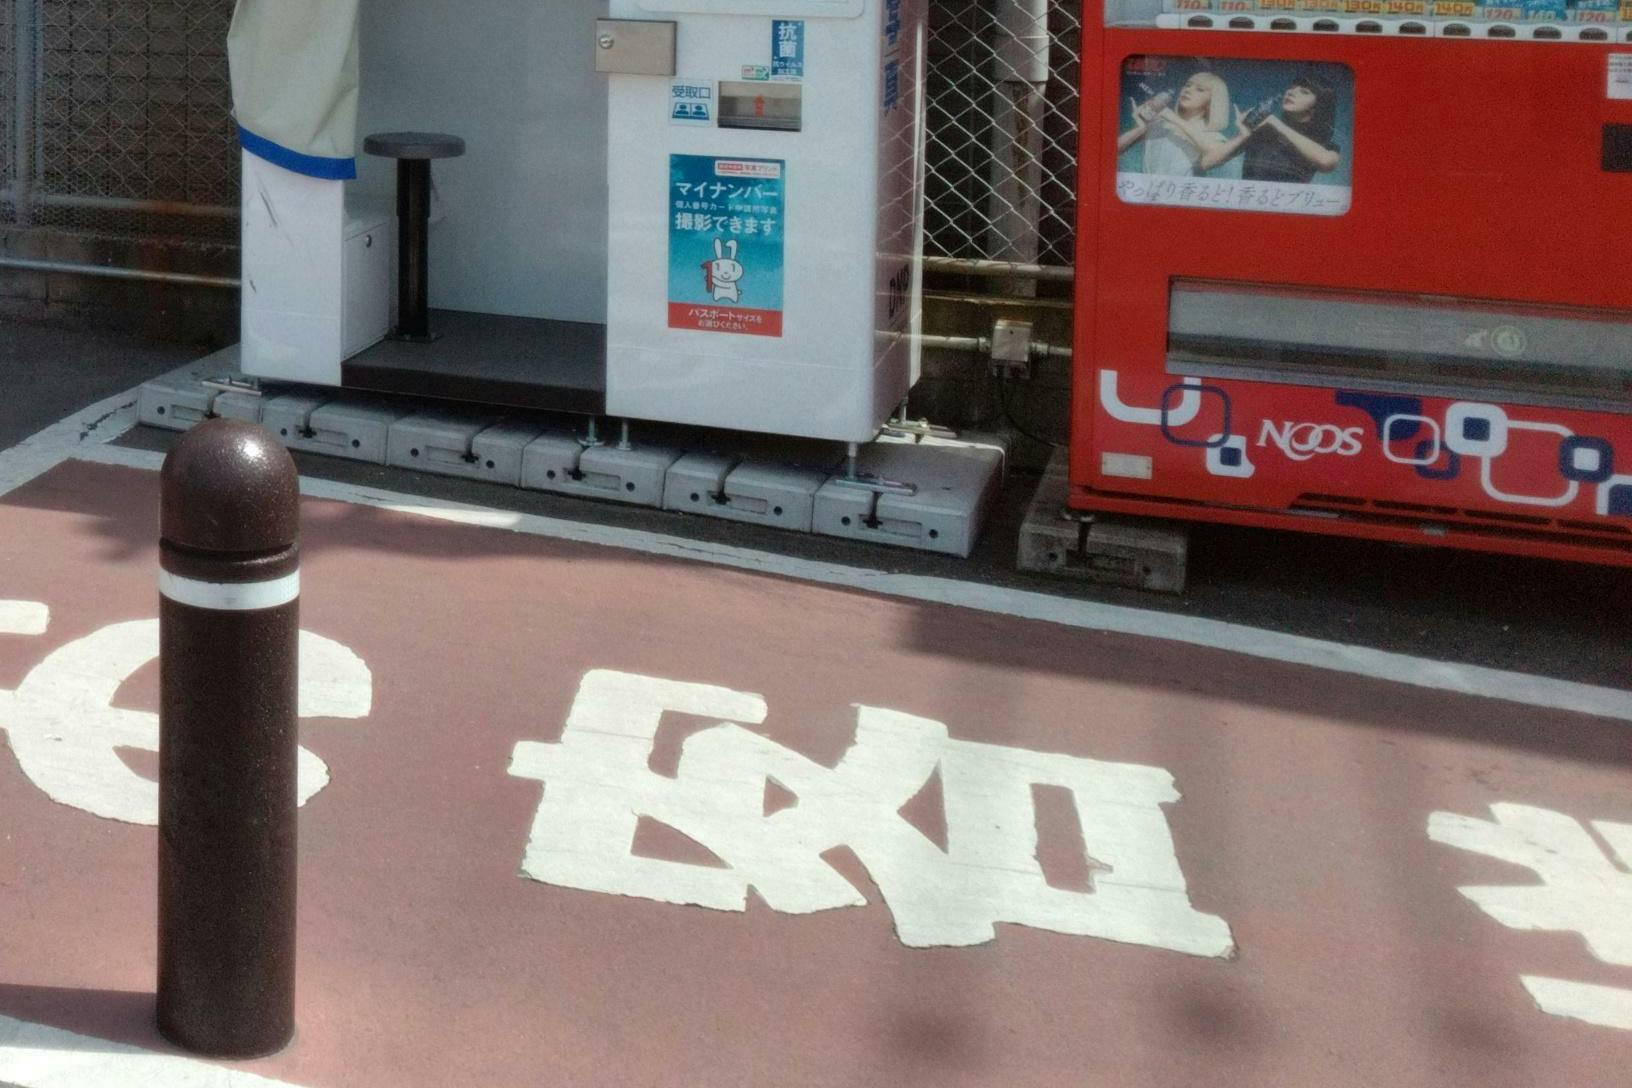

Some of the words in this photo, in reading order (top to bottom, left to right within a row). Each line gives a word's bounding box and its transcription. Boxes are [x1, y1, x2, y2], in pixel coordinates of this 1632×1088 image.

[778, 22, 798, 58] 抗菌
[671, 85, 711, 99] 受取口
[675, 182, 778, 199] マイナンバー
[675, 212, 776, 235] 撮影できます
